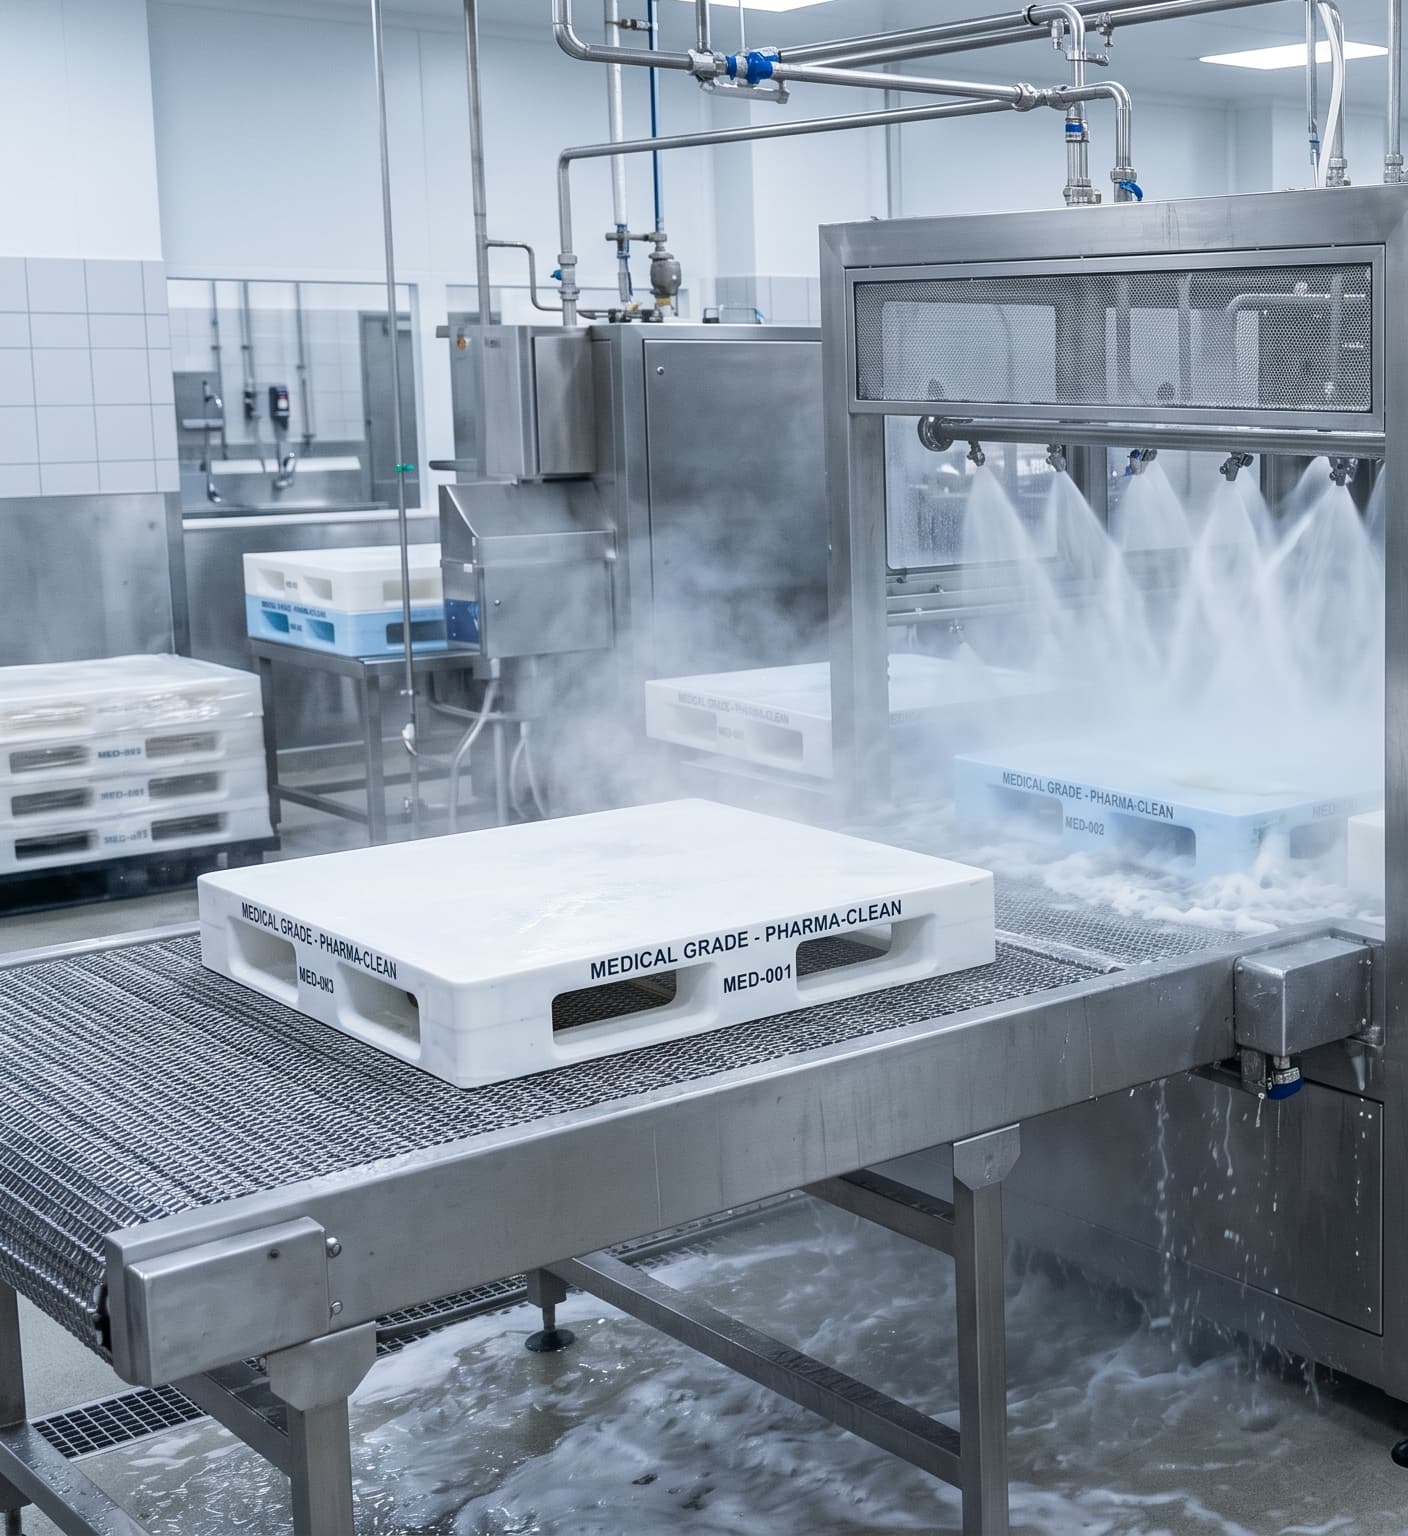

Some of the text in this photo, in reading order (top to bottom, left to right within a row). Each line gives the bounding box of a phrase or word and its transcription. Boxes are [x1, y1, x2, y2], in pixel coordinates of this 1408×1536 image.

[1002, 771, 1045, 793] MEDICAL
[1047, 780, 1082, 801] GRADE
[1090, 789, 1174, 820] PHARMA-CLEAN
[1065, 815, 1105, 836] MED-002
[242, 902, 279, 932] MEDICAL
[280, 918, 313, 946] GRADE
[319, 933, 397, 981] PHARMA-CLEAN
[590, 945, 679, 980] MEDICAL
[683, 930, 749, 960] GRADE
[765, 899, 903, 943] PHARMA-CLEAN
[723, 963, 793, 994] MED-001
